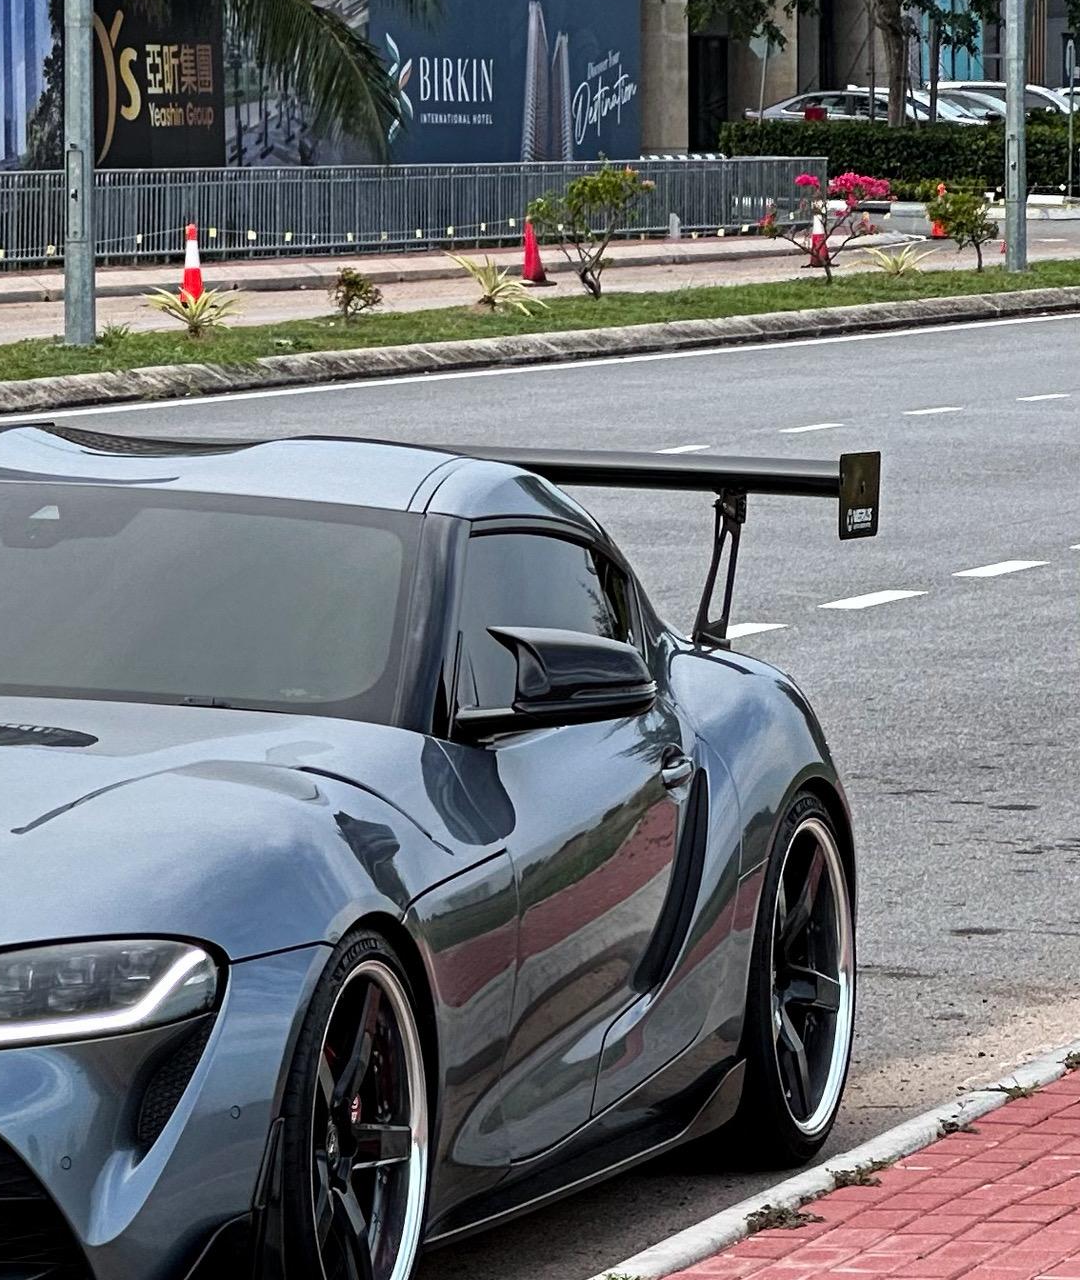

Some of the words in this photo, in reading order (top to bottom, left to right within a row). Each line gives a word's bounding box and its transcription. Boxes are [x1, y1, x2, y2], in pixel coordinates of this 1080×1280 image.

[145, 44, 213, 95] 亞昕集團
[419, 56, 494, 103] BIRKIN
[148, 101, 185, 127] Yeashin
[186, 101, 214, 130] Group
[420, 112, 471, 125] INTERNATIONAL
[472, 113, 493, 125] HOTEL
[572, 63, 638, 145] Destination
